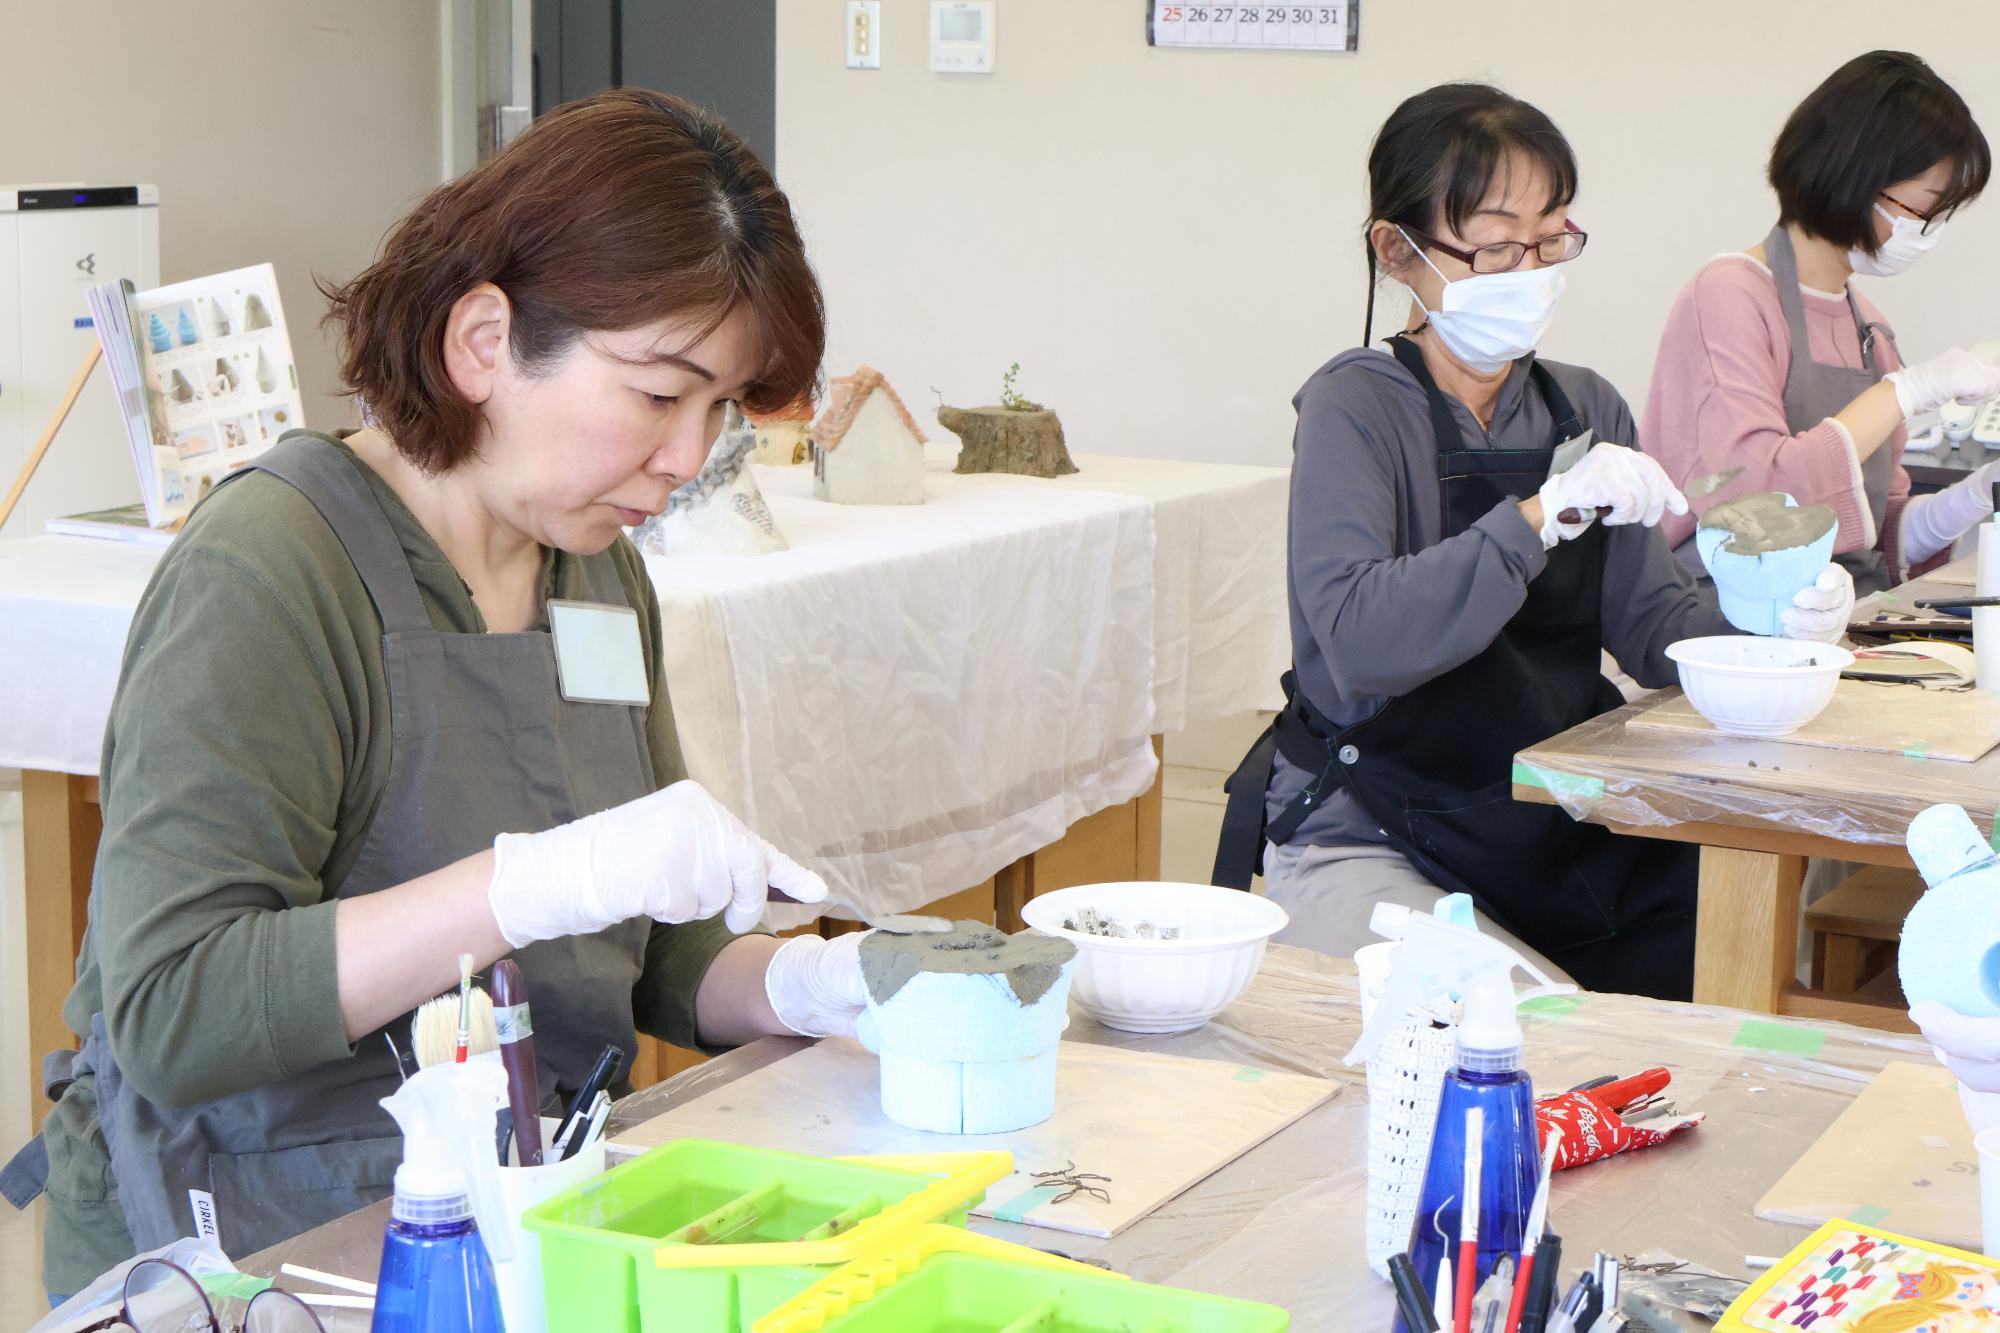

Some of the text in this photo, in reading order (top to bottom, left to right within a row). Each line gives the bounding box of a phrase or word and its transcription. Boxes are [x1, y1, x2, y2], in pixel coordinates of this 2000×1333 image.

[1162, 7, 1337, 24] 25 26 27 28 29 30 31
[198, 1200, 215, 1235] CIRKEL
